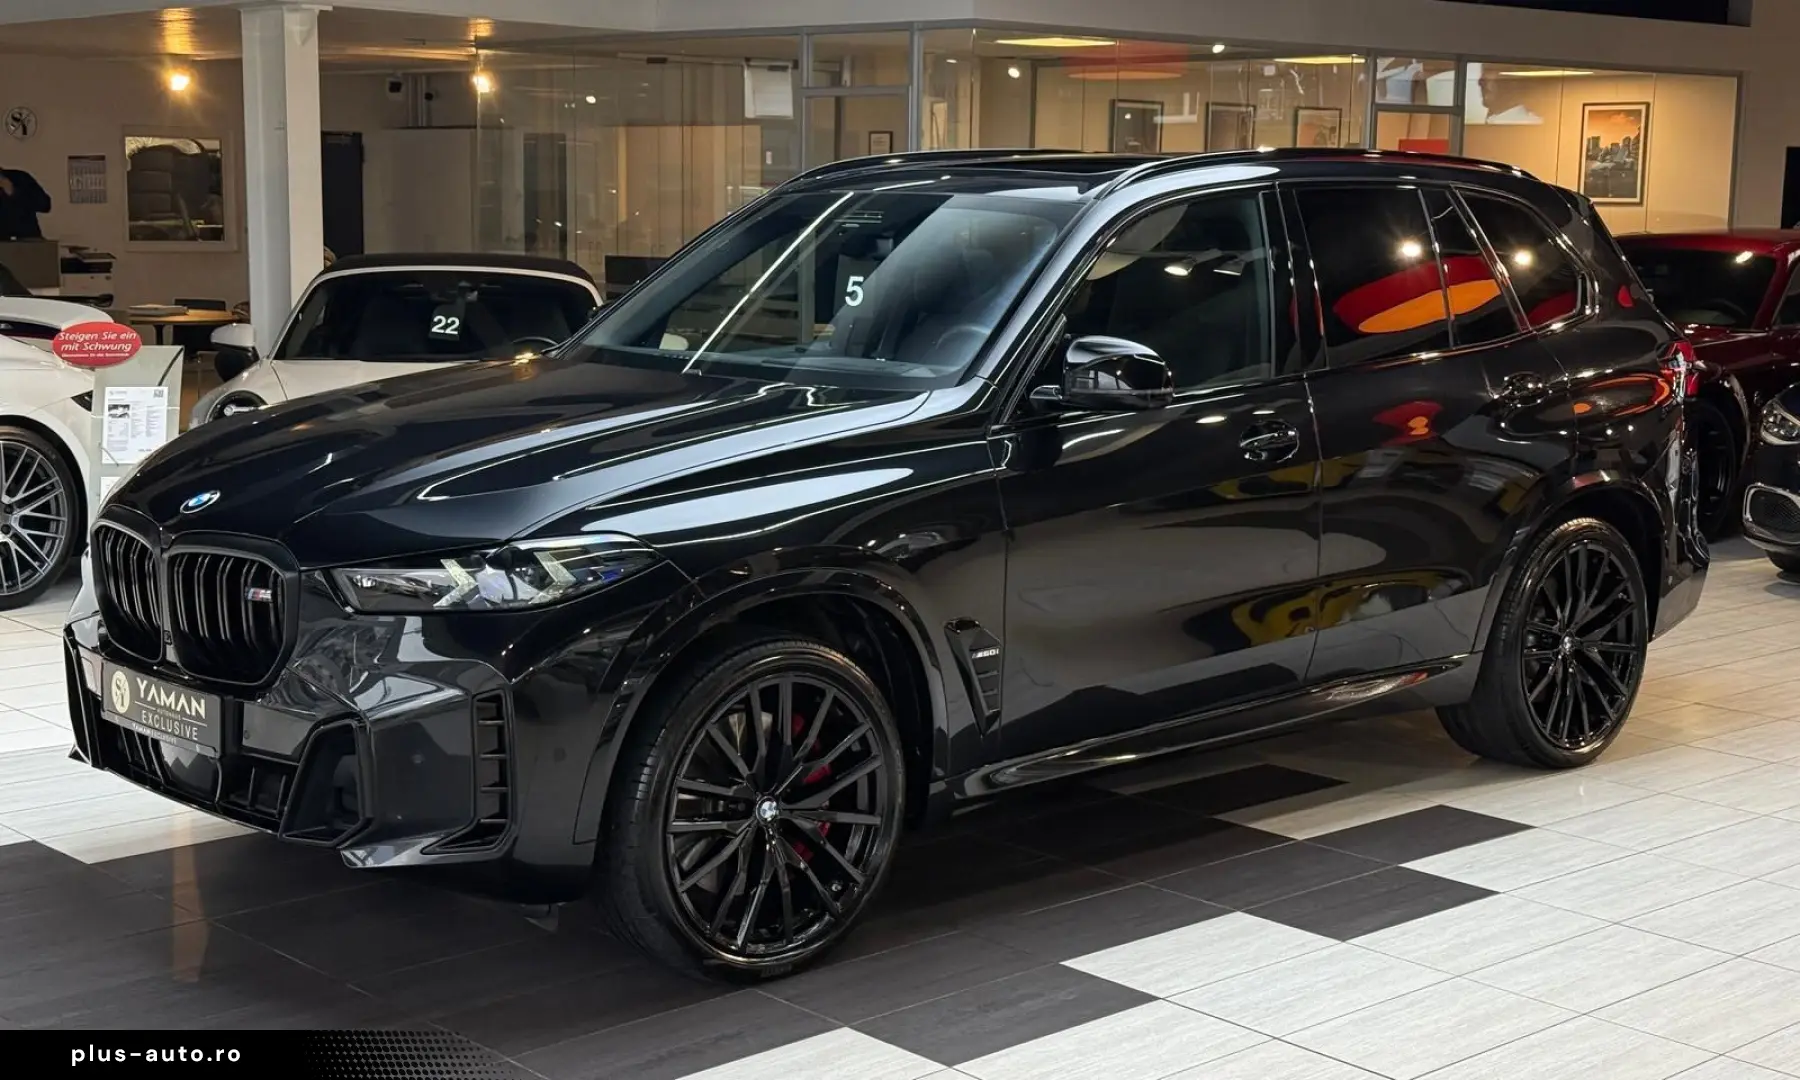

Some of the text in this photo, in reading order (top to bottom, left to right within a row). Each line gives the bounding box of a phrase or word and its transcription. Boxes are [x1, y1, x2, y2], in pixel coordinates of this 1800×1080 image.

[845, 275, 864, 307] 5
[58, 331, 137, 343] Steigen Sie ein
[431, 315, 460, 335] 22
[60, 342, 132, 352] mit Schwung
[136, 676, 206, 719] YAMAN
[141, 710, 199, 741] EXCLUSIVE
